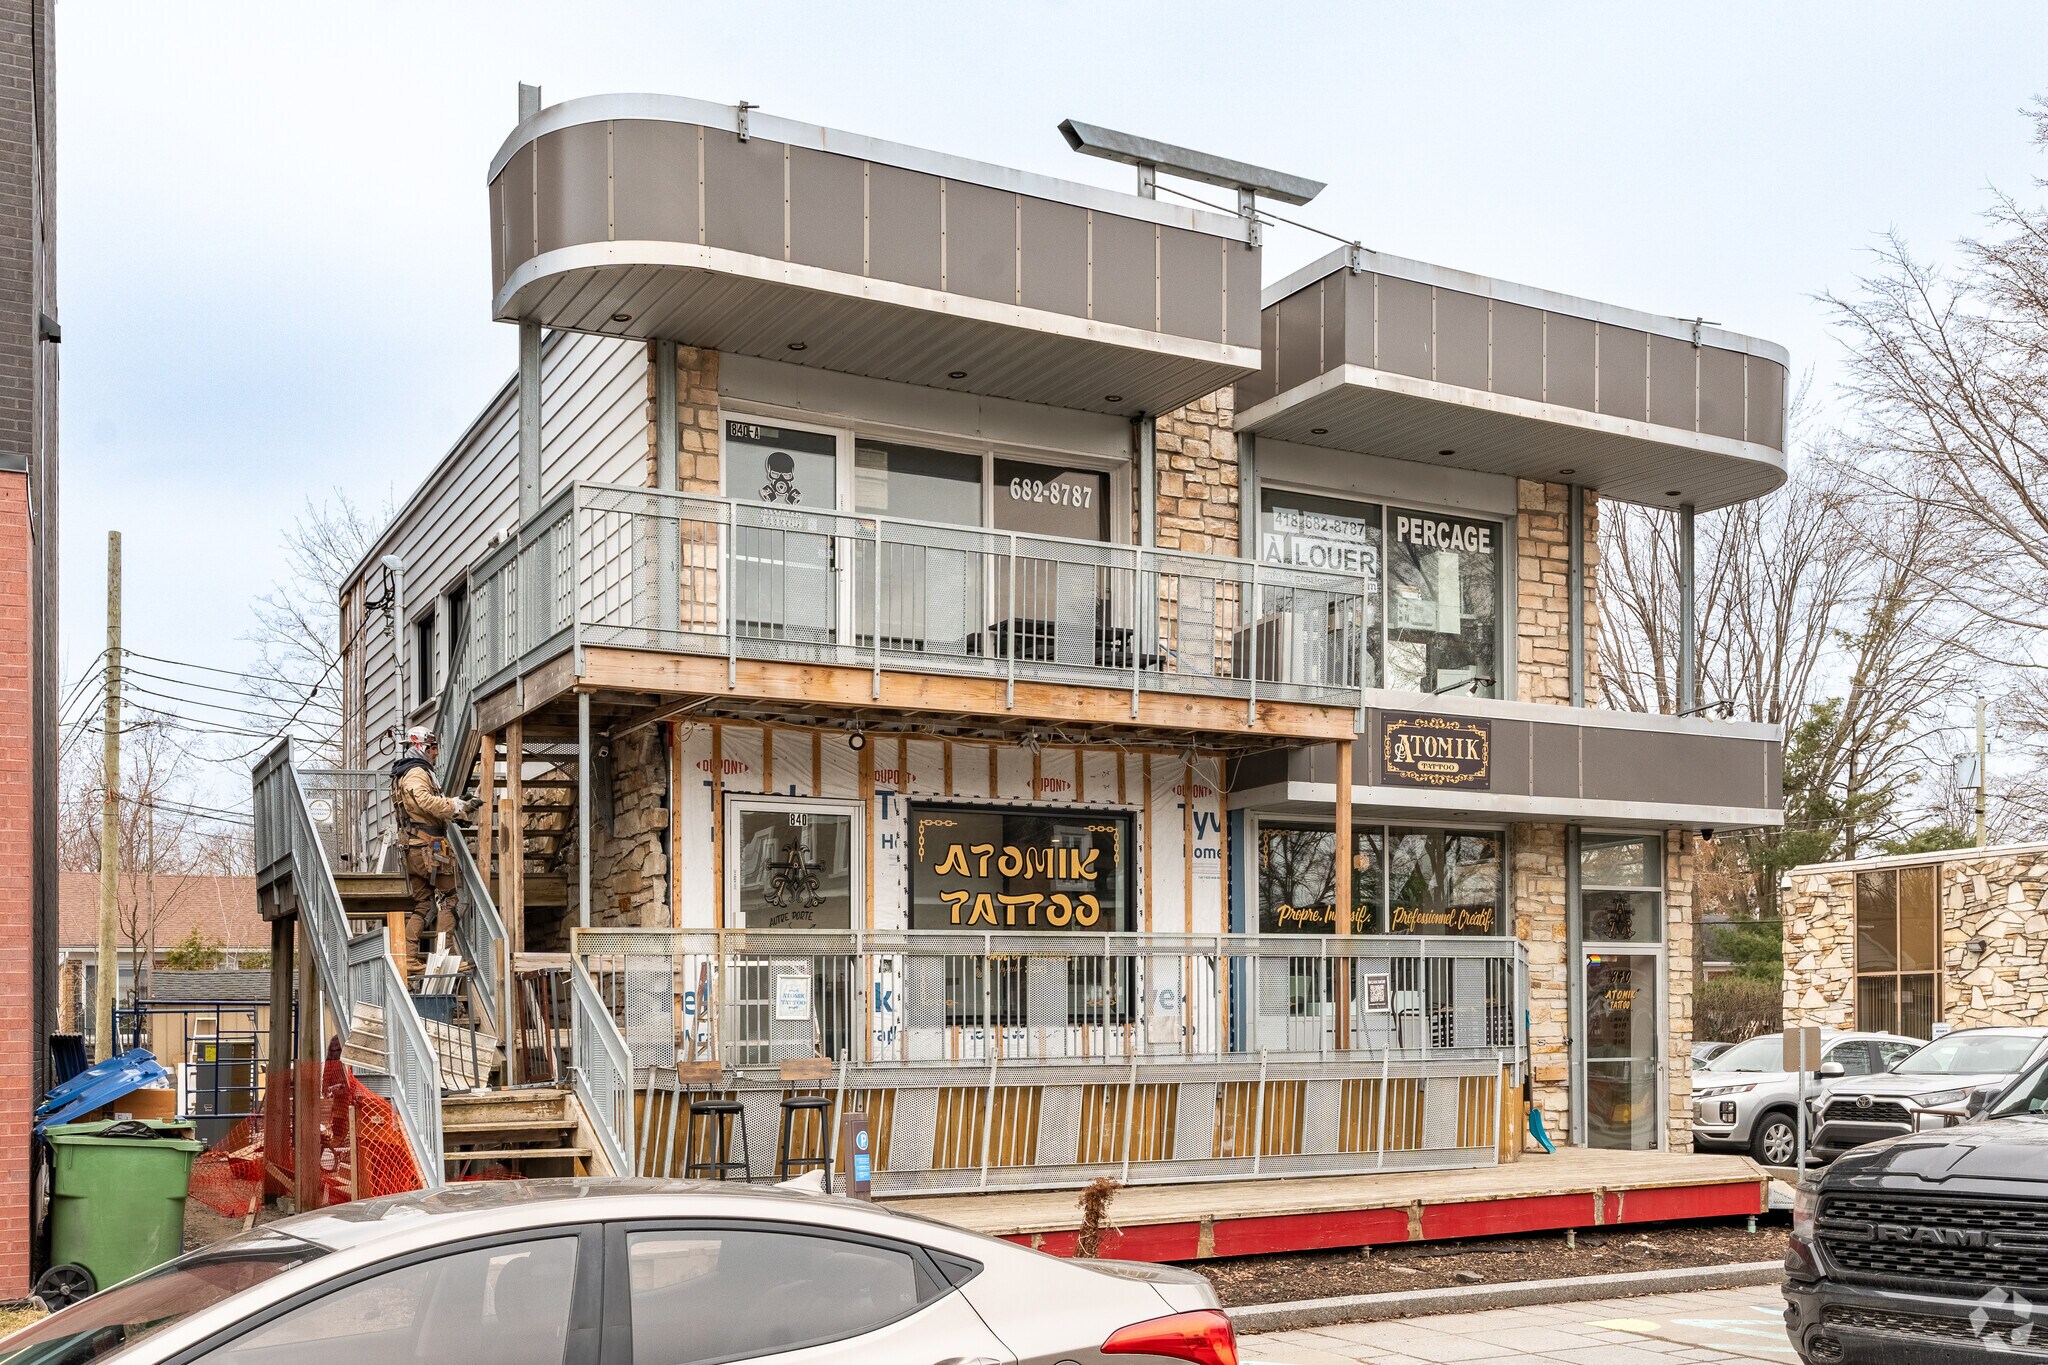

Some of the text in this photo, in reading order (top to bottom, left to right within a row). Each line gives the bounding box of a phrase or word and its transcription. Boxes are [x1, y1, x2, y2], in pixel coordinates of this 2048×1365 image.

[731, 422, 760, 439] 840-A
[1010, 477, 1092, 508] 682-8787
[1397, 516, 1491, 554] PERÇAGE
[1265, 536, 1376, 575] À LOUER
[1394, 735, 1480, 763] ATOMIK
[702, 759, 743, 775] DUONT
[1421, 763, 1455, 771] TATTOO
[874, 769, 911, 785] DUPOT
[790, 813, 807, 826] 840
[1183, 844, 1221, 859] ome
[934, 843, 1100, 881] ATOMIK
[939, 889, 1100, 928] TATTOO
[769, 910, 814, 928] AUTRE PORTE
[1277, 904, 1323, 929] Propre.
[1324, 904, 1371, 933] Insif.
[1392, 906, 1457, 932] Professionnel.
[1605, 989, 1636, 1000] ATOMIK
[1610, 1000, 1631, 1010] TATTOO
[1878, 1224, 1985, 1248] RAM
